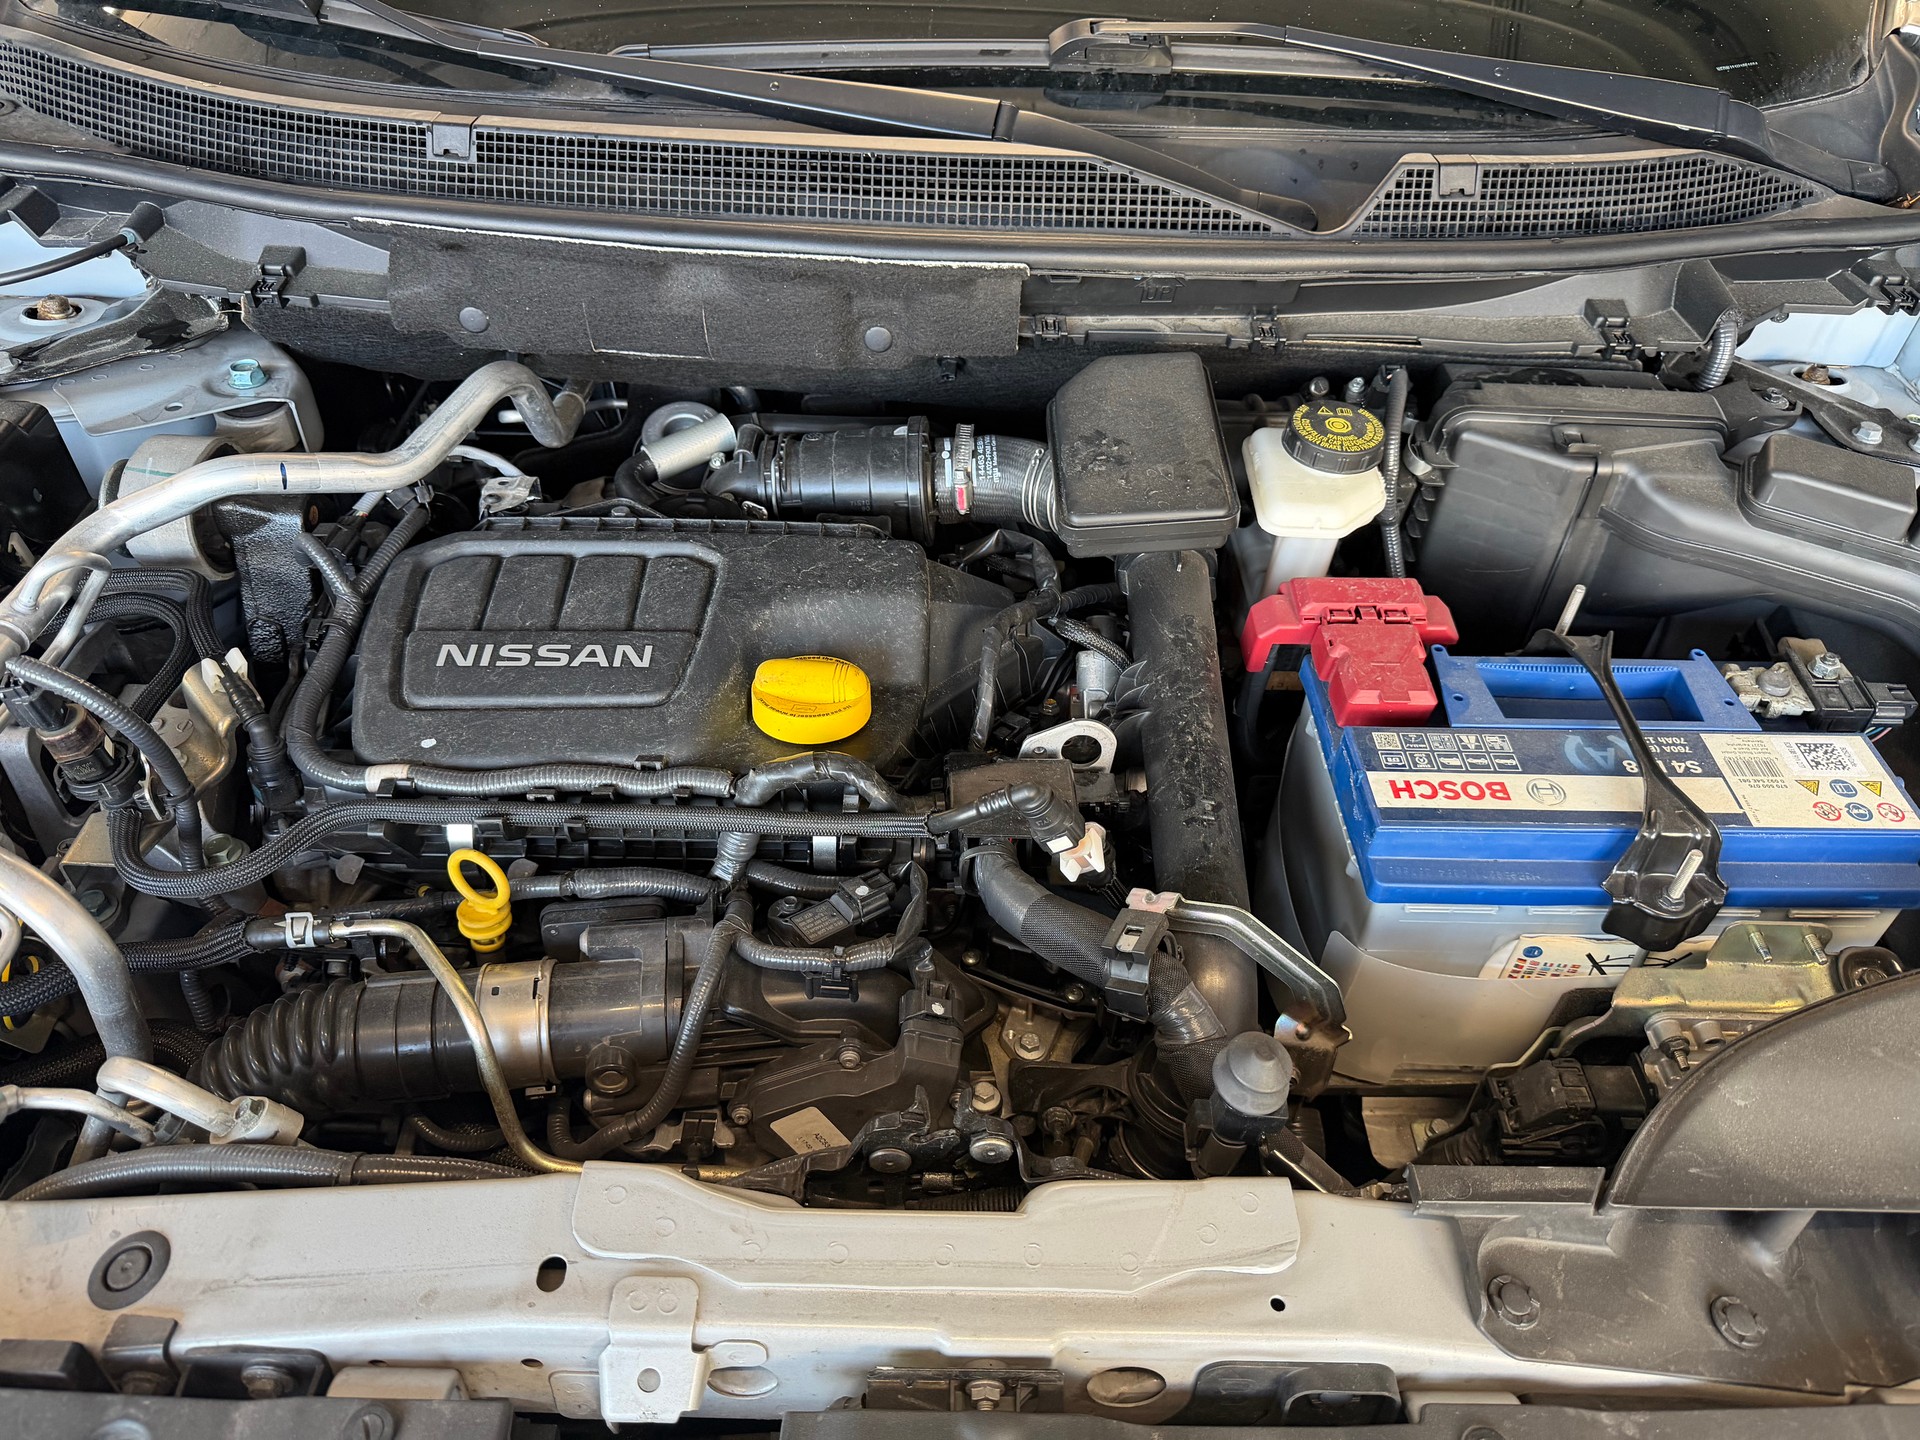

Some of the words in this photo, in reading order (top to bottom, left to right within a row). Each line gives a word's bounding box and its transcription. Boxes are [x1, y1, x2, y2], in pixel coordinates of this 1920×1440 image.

[1147, 285, 1173, 300] UP
[1310, 430, 1328, 442] FILLER
[1321, 442, 1341, 451] BRAKE
[436, 644, 653, 668] NISSAN
[1671, 760, 1702, 774] S4
[1388, 780, 1512, 801] BOSCH
